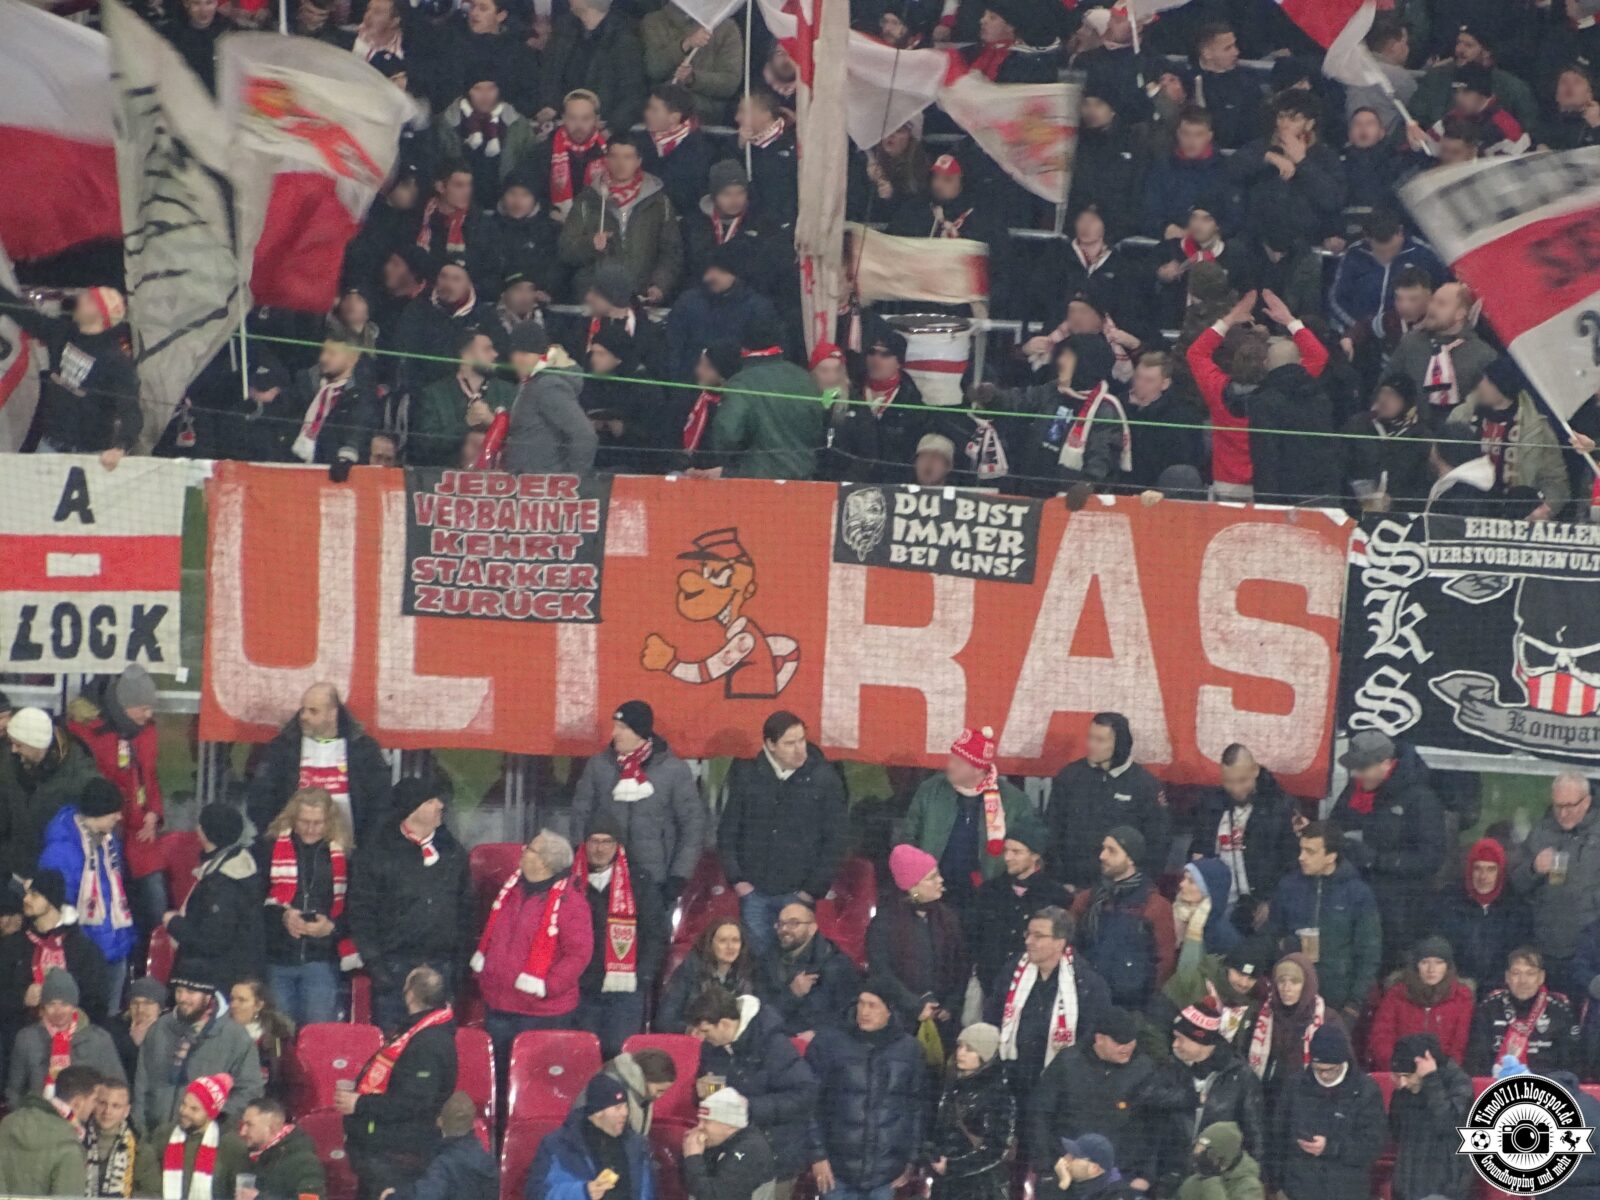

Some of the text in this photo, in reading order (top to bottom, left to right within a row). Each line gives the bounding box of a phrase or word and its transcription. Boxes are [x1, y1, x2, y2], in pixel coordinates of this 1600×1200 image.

[54, 466, 95, 524] A
[435, 471, 580, 499] JEDER
[413, 492, 600, 532] VERBANNTE
[894, 493, 1030, 527] DU BIST
[431, 529, 584, 560] KEHRT
[892, 516, 1025, 556] IMMER
[1464, 517, 1530, 541] EHRE
[890, 544, 1026, 577] BEI UNS!
[1428, 546, 1569, 569] VERSTORBENEN
